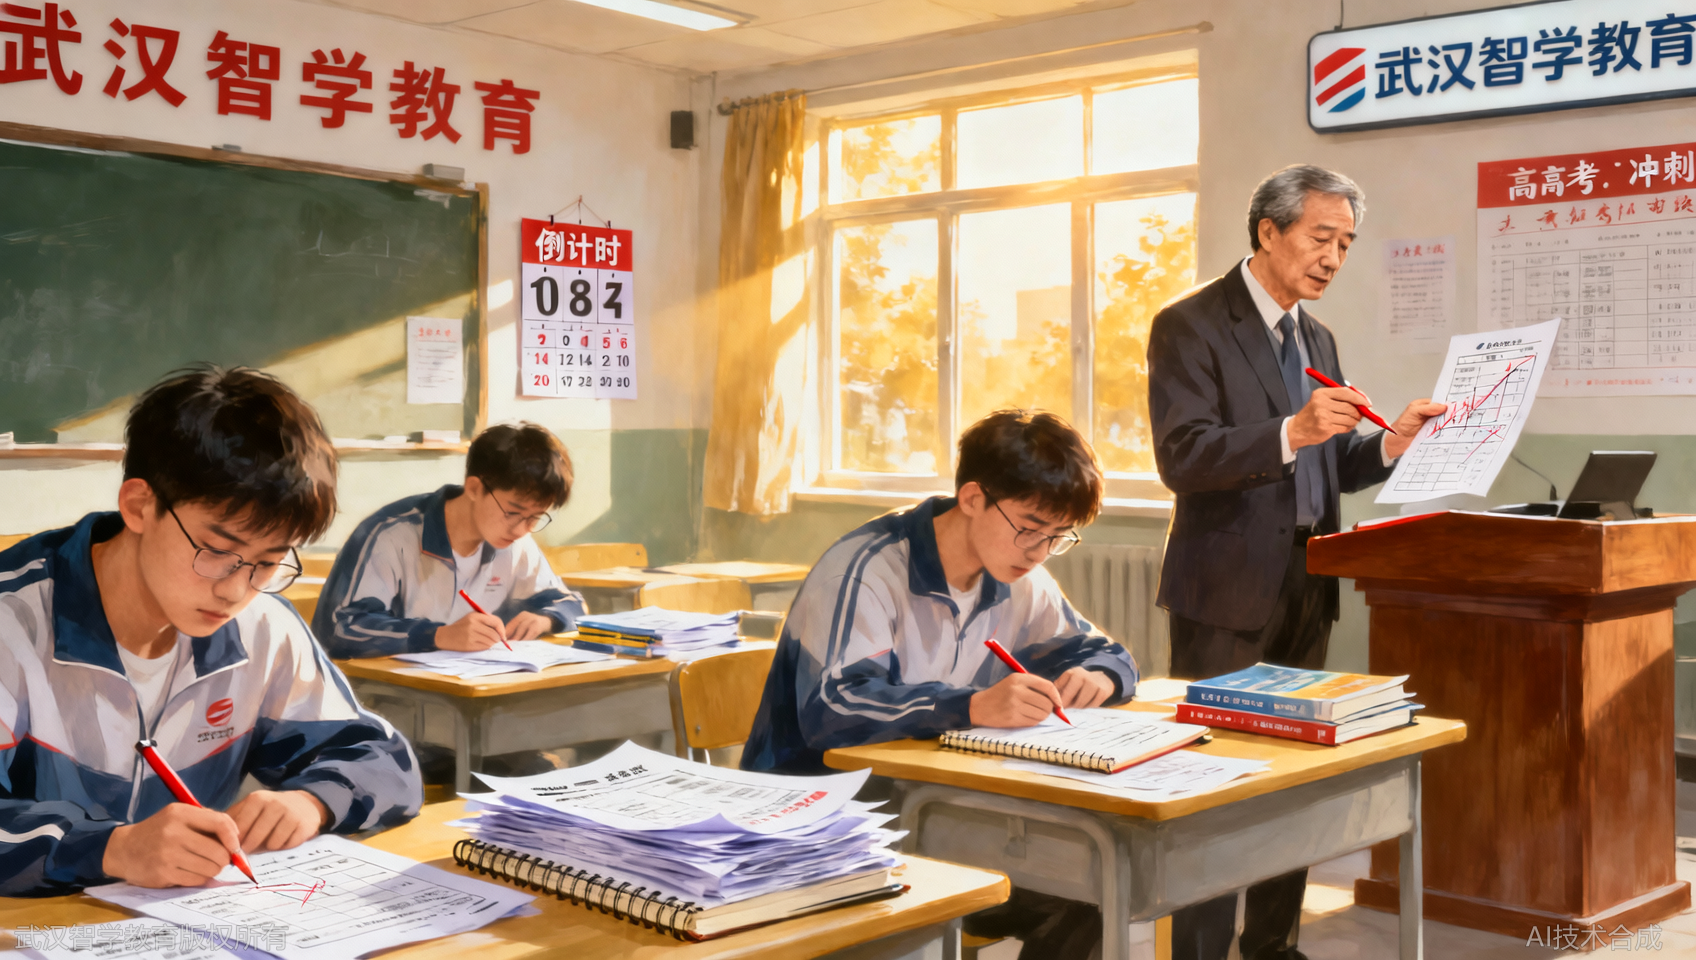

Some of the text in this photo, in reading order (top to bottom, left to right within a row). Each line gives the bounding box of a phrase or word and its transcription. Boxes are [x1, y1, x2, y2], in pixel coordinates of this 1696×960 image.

[1375, 13, 1696, 99] 武汉智学教育
[0, 1, 541, 155] 武汉智学教育
[535, 227, 622, 266] 倒计时
[560, 353, 574, 366] 12
[602, 355, 611, 367] 2
[616, 355, 630, 367] 10
[534, 374, 550, 386] 20
